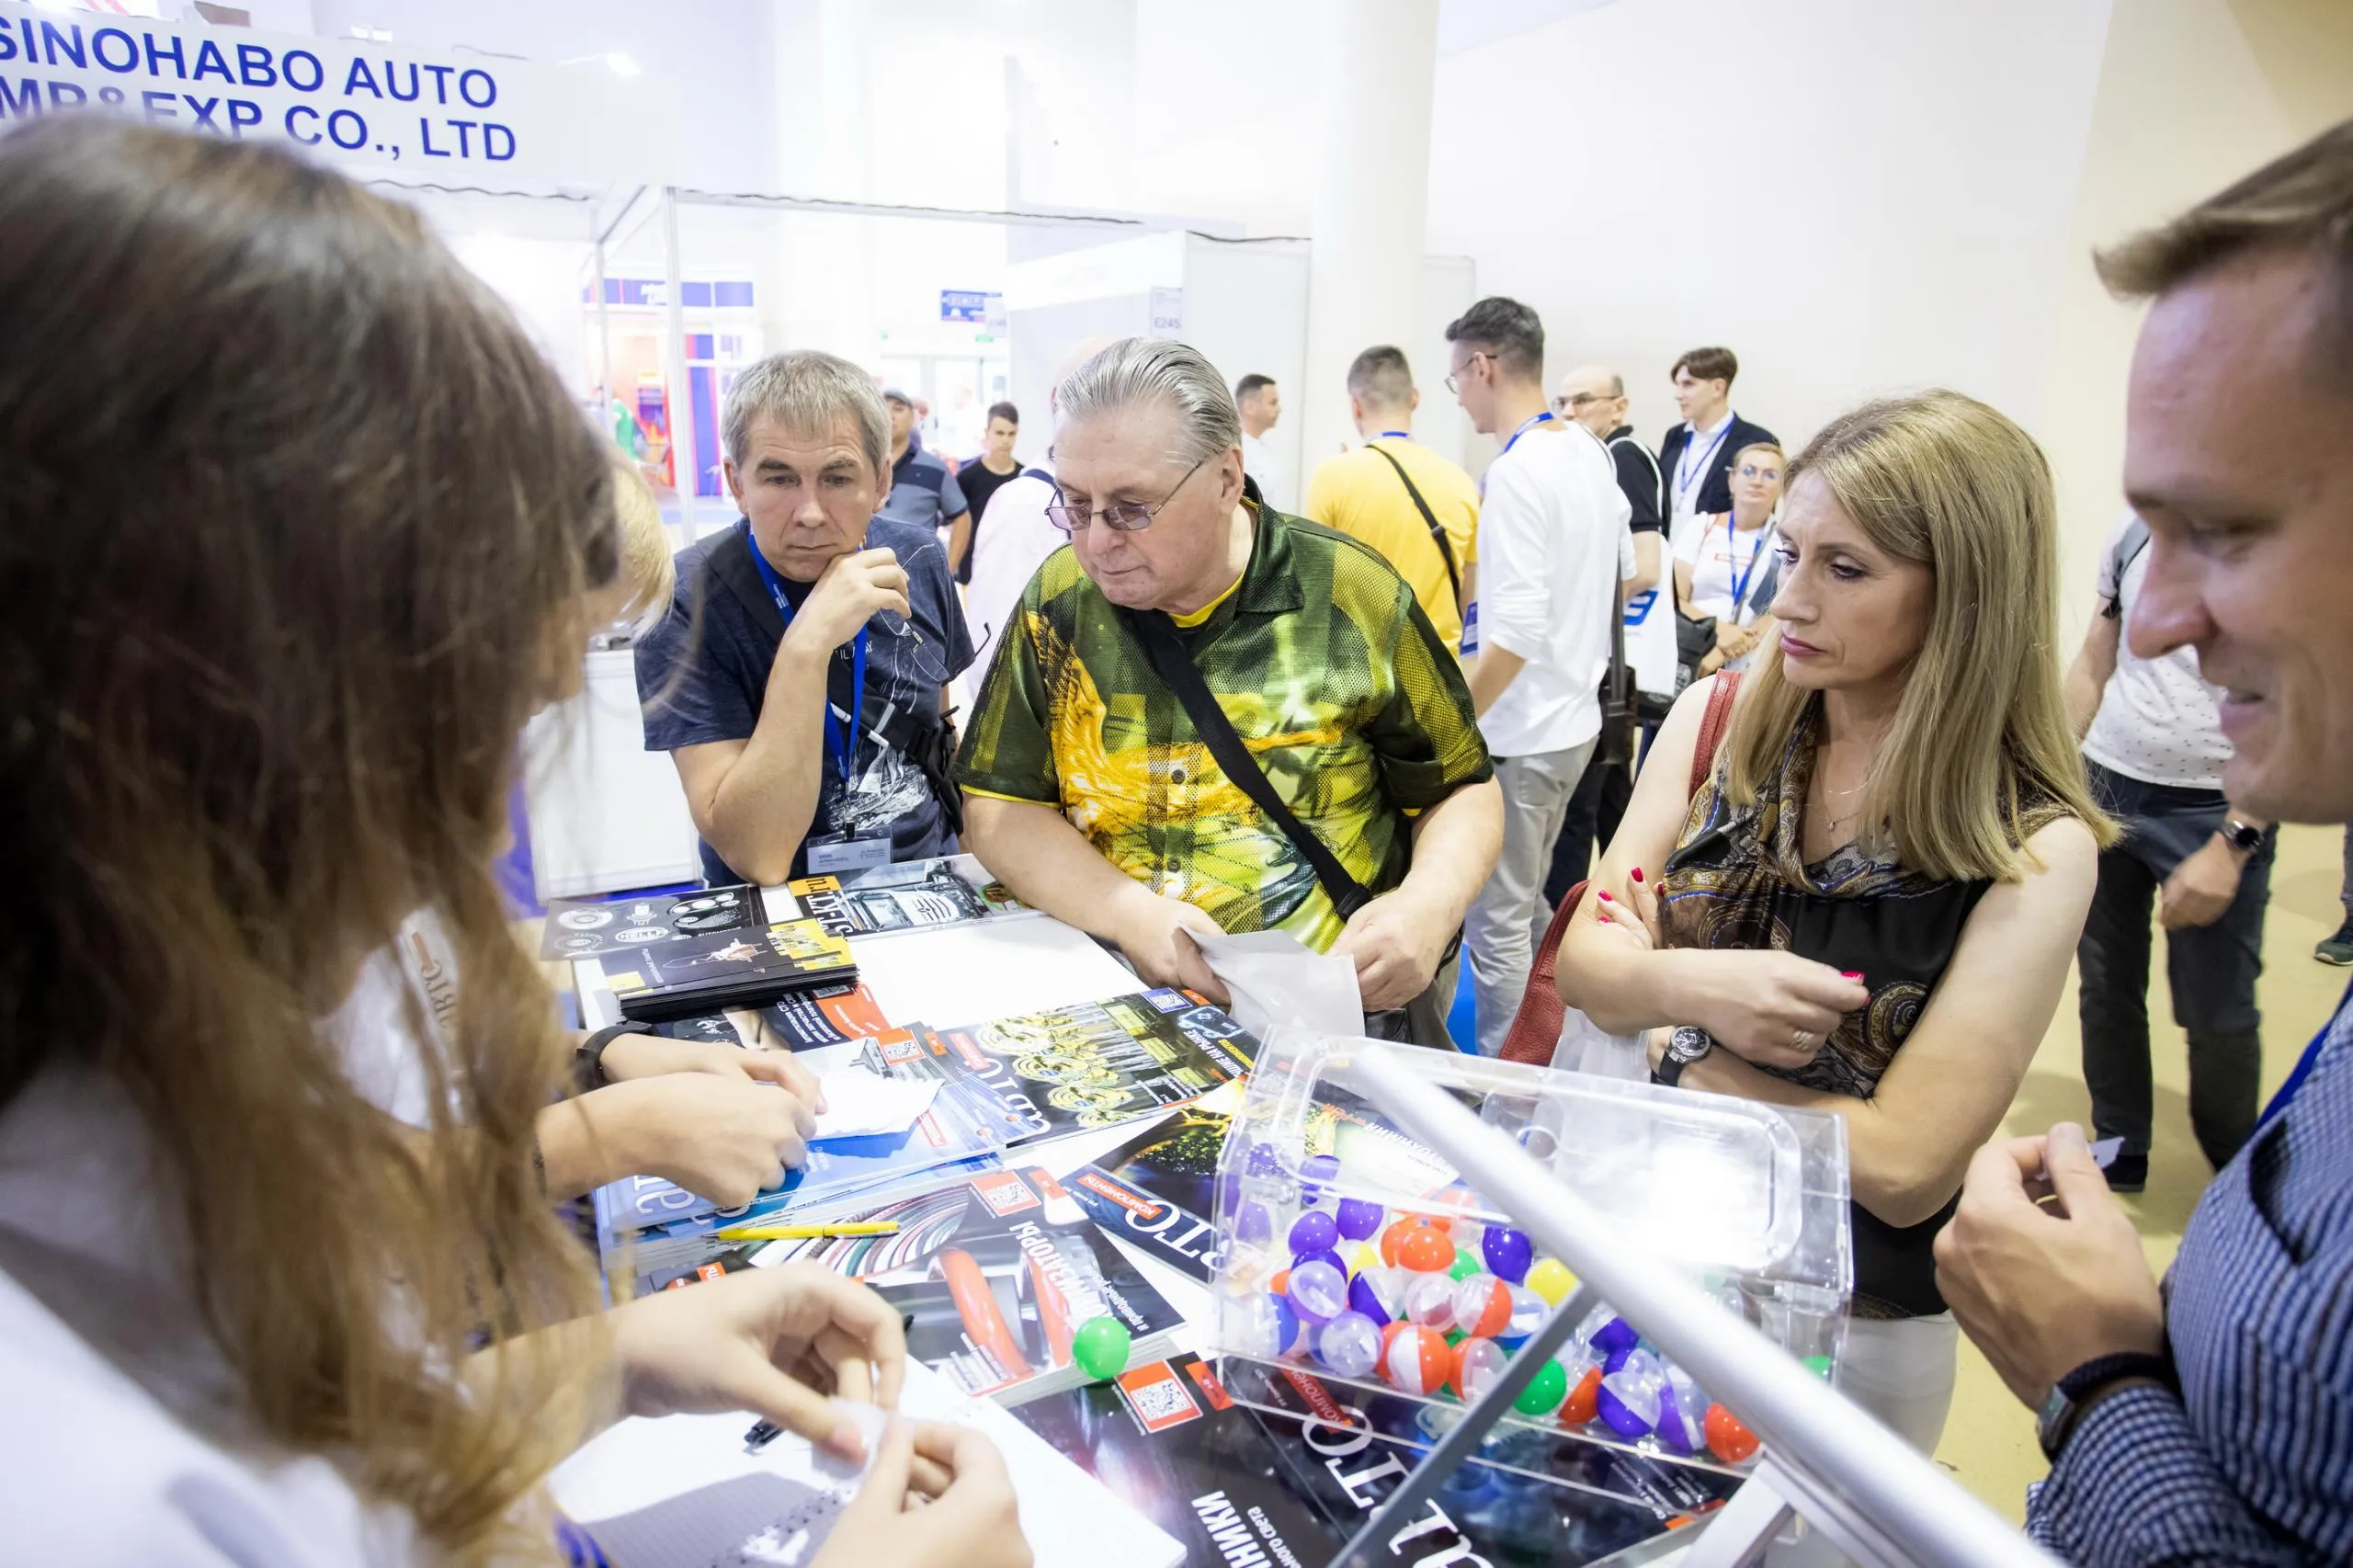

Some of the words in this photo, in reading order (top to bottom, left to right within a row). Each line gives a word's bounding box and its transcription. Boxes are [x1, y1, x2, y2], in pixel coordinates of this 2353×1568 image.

[0, 16, 324, 93] SINOHABO
[344, 57, 497, 108] AUTO
[284, 105, 400, 161] CO.,
[421, 118, 517, 162] LTD
